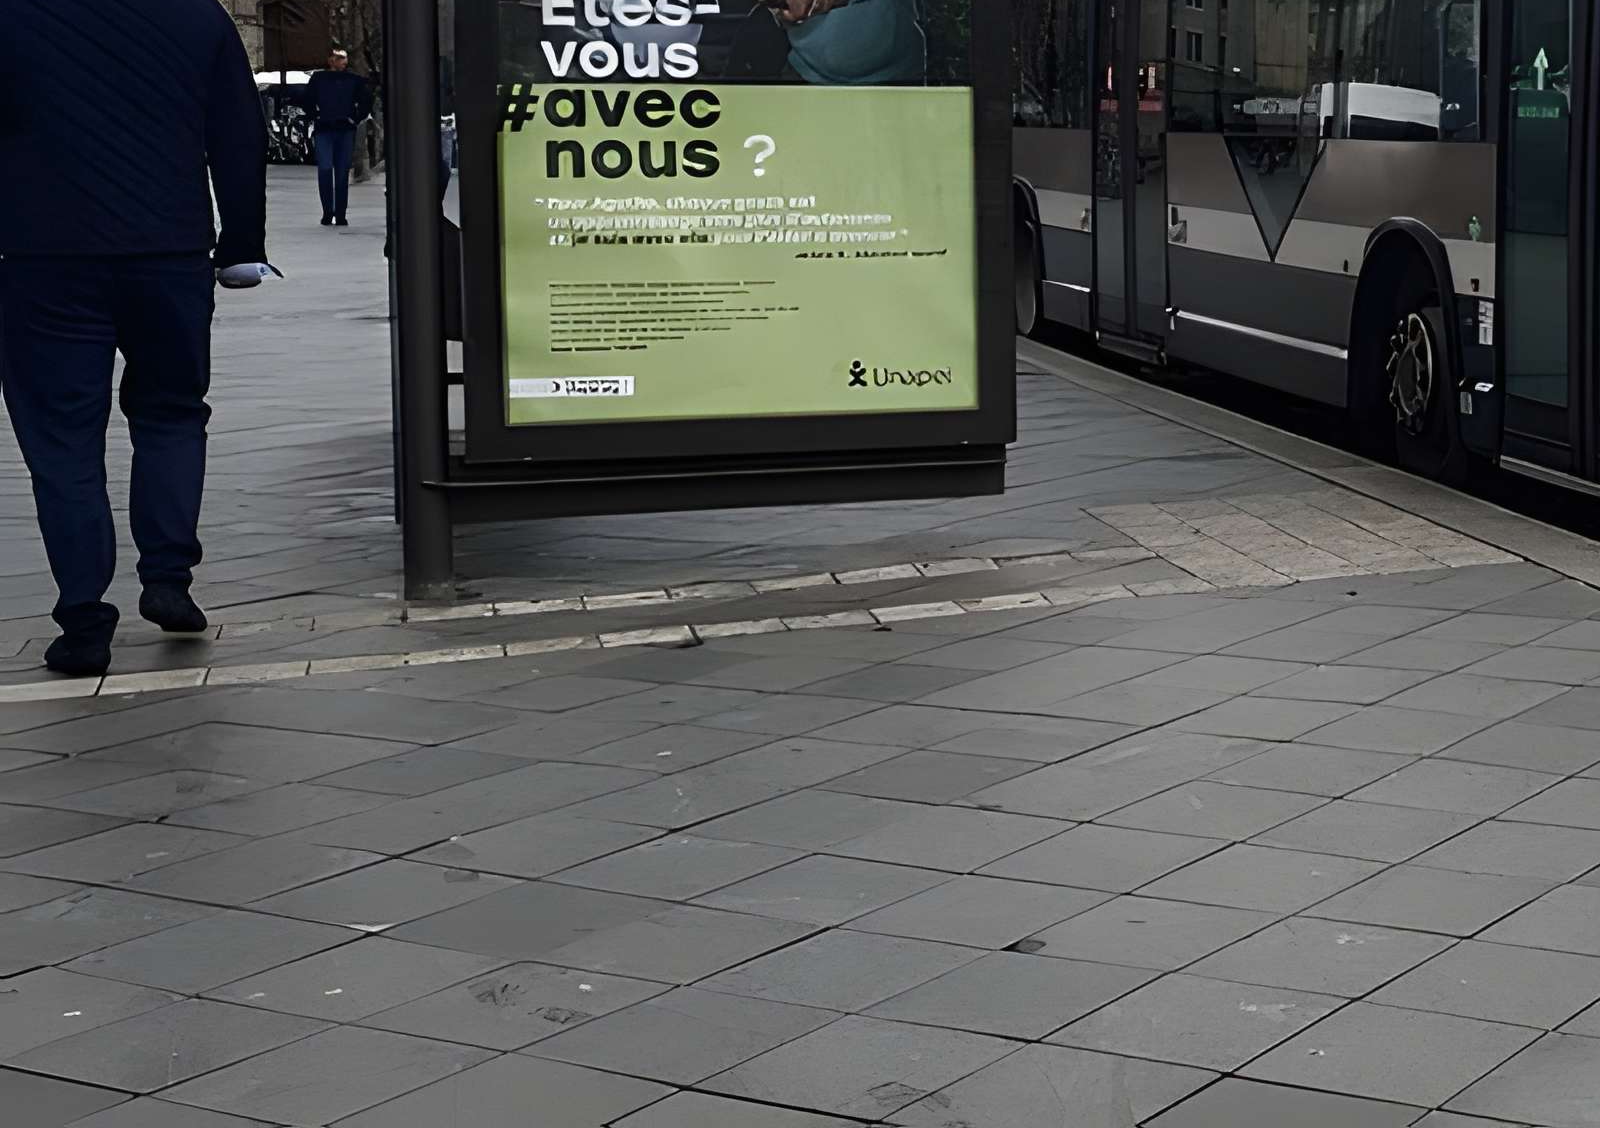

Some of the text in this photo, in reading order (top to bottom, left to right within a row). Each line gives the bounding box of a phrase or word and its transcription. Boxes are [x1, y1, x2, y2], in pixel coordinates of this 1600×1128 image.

[540, 40, 699, 79] vous
[500, 83, 721, 132] #avec
[545, 134, 776, 179] nous ?
